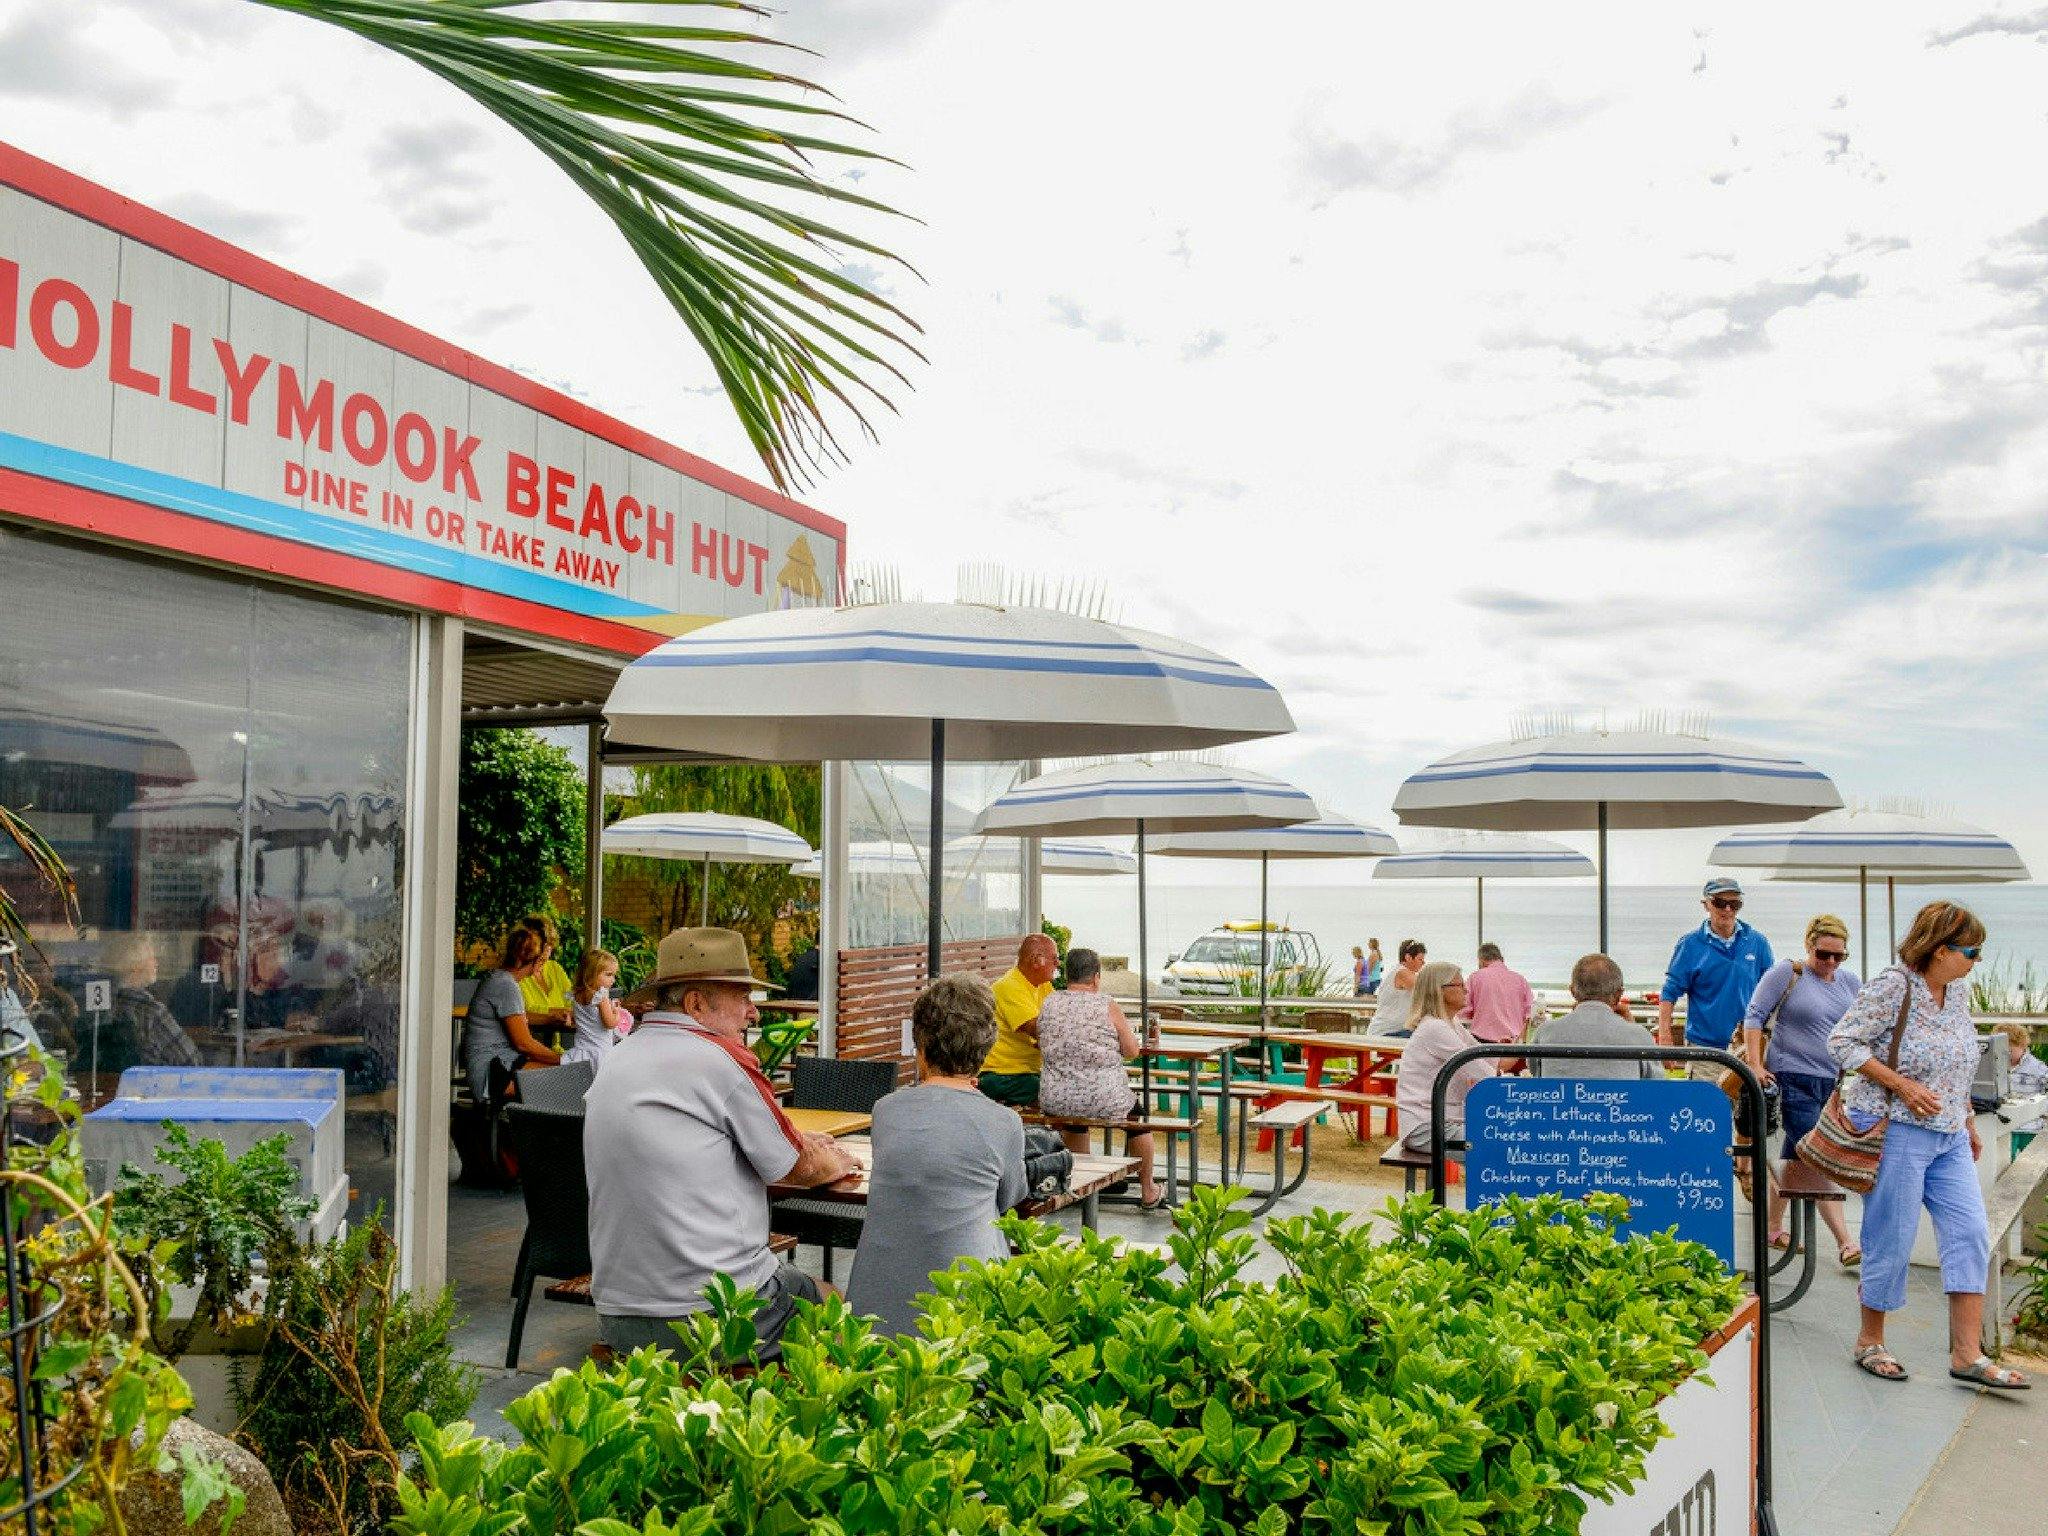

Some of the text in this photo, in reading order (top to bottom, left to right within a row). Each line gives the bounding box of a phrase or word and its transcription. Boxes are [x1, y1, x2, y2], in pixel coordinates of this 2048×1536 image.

[0, 257, 769, 594] OLLYMOOK BEACH HUT
[283, 460, 621, 589] DINE IN OR TAKE AWAY
[94, 985, 103, 1006] 3
[1500, 1082, 1629, 1107] Tropical Burger
[1609, 1105, 1654, 1123] Bacon
[1483, 1124, 1532, 1141] Cheese
[1537, 1130, 1563, 1141] with
[1506, 1144, 1628, 1168] Mexican Burger
[1480, 1167, 1531, 1183] Chicken
